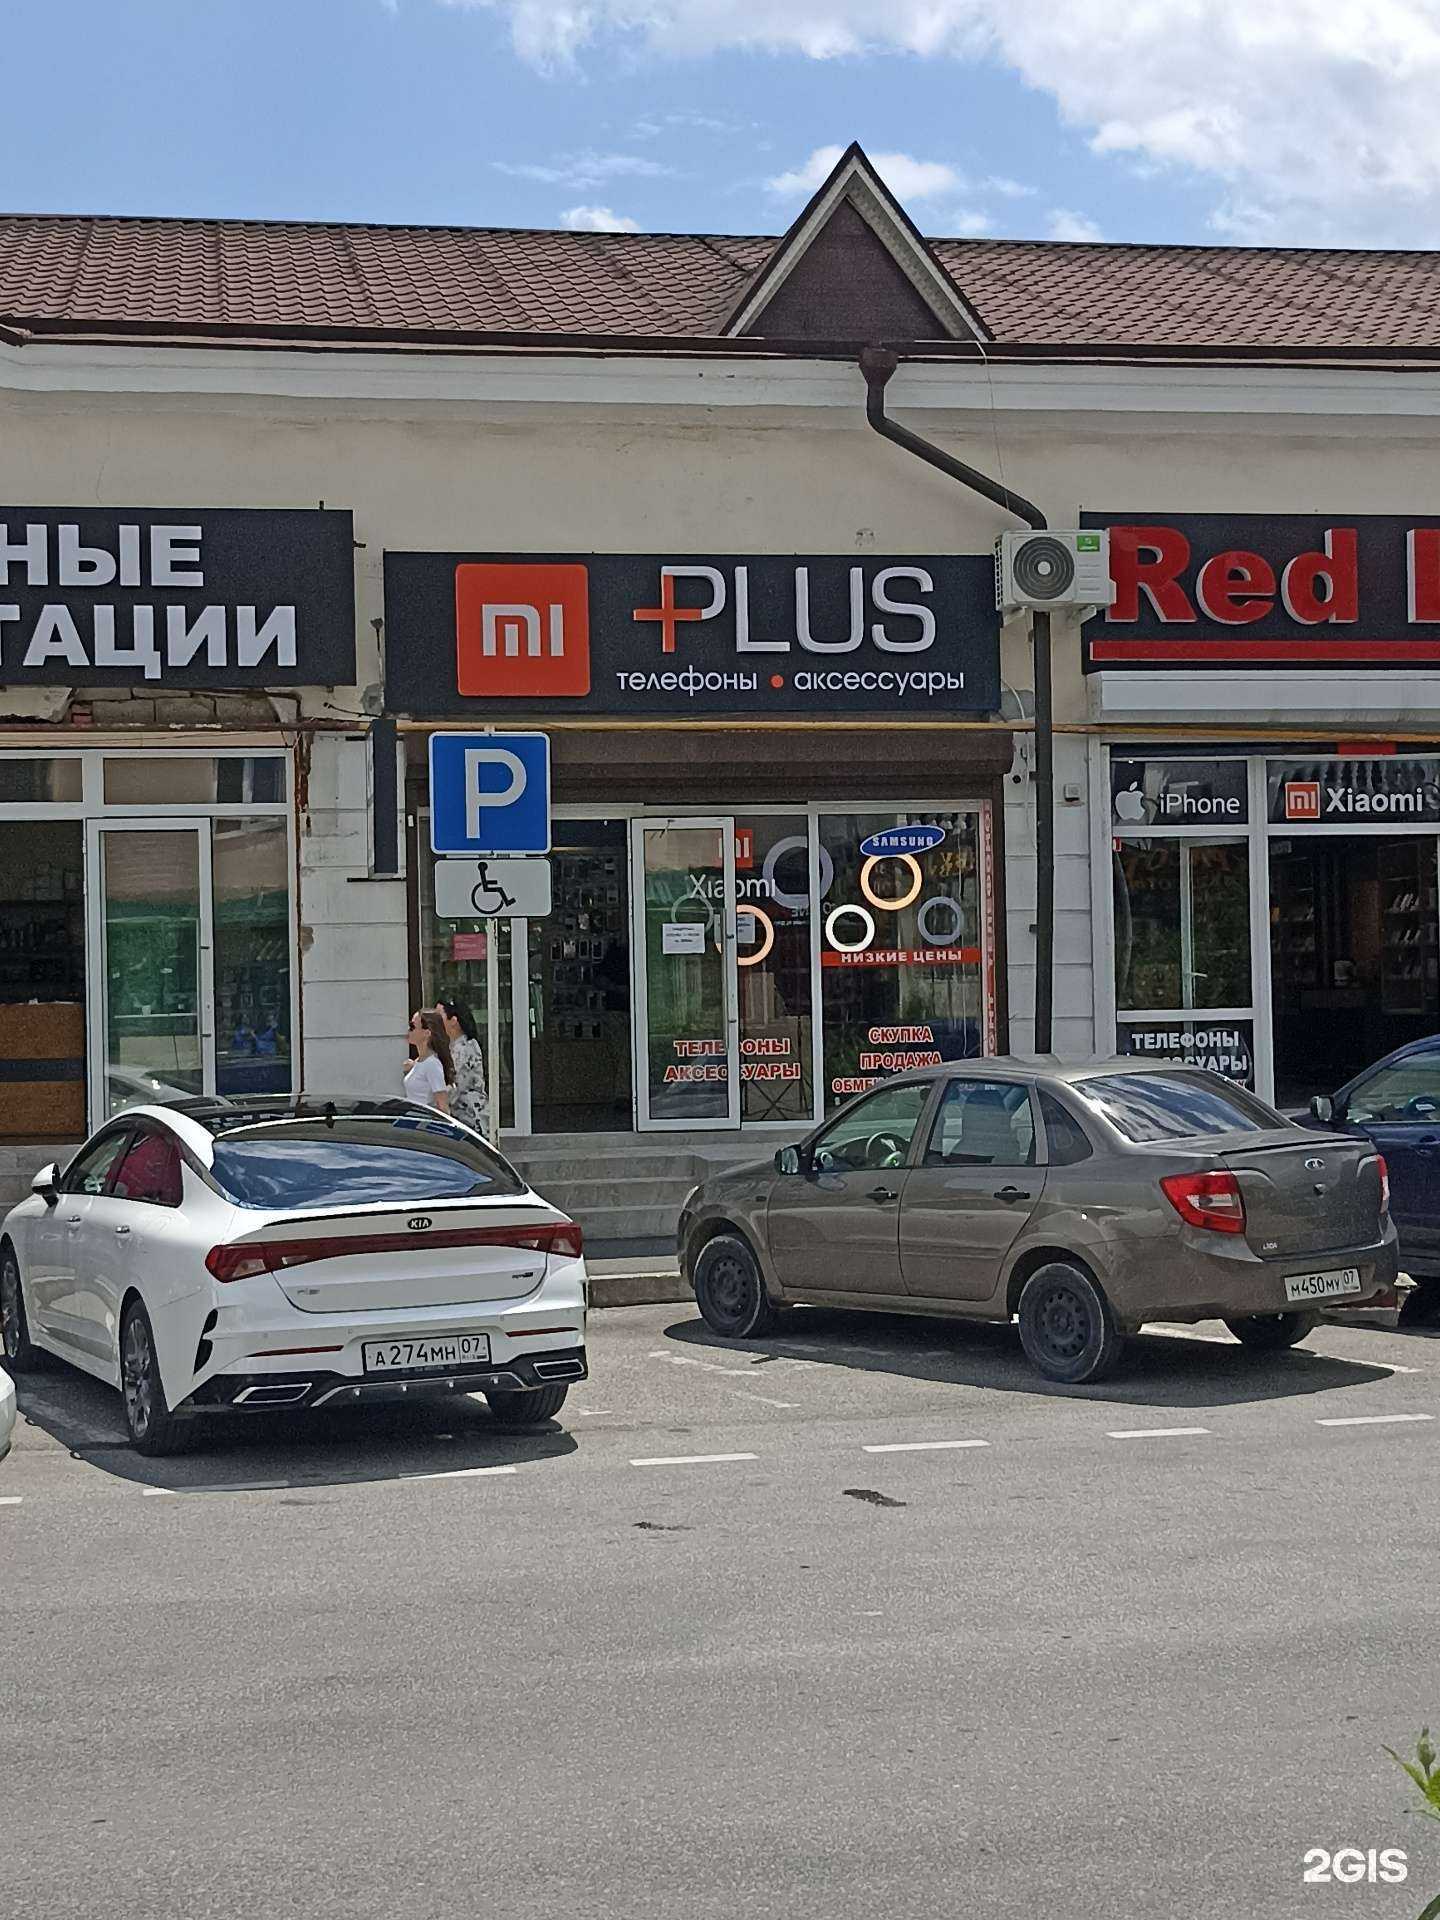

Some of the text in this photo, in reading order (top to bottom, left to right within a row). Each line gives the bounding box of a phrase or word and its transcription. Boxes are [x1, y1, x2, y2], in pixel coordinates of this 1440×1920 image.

[0, 524, 204, 587] НЫЕ
[1105, 526, 1359, 625] Red
[617, 665, 964, 696] телефоны аксессуары
[465, 748, 527, 839] P
[1326, 787, 1423, 813] Xiaomi
[1160, 793, 1240, 814] iPhone
[873, 832, 934, 847] SAMSUNG
[841, 950, 962, 964] НИЗКИЕ ЦЕНЫ
[868, 1026, 934, 1044] СКУПКА
[1131, 1031, 1240, 1050] ТЕЛЕФОНЫ
[673, 1038, 791, 1057] ТЕЛЕОНЫ
[860, 1052, 942, 1071] ПРОДАЖА
[663, 1062, 801, 1083] АКСЕСУАРЫ
[832, 1077, 889, 1093] ОБМЕ
[410, 1218, 430, 1228] KIA
